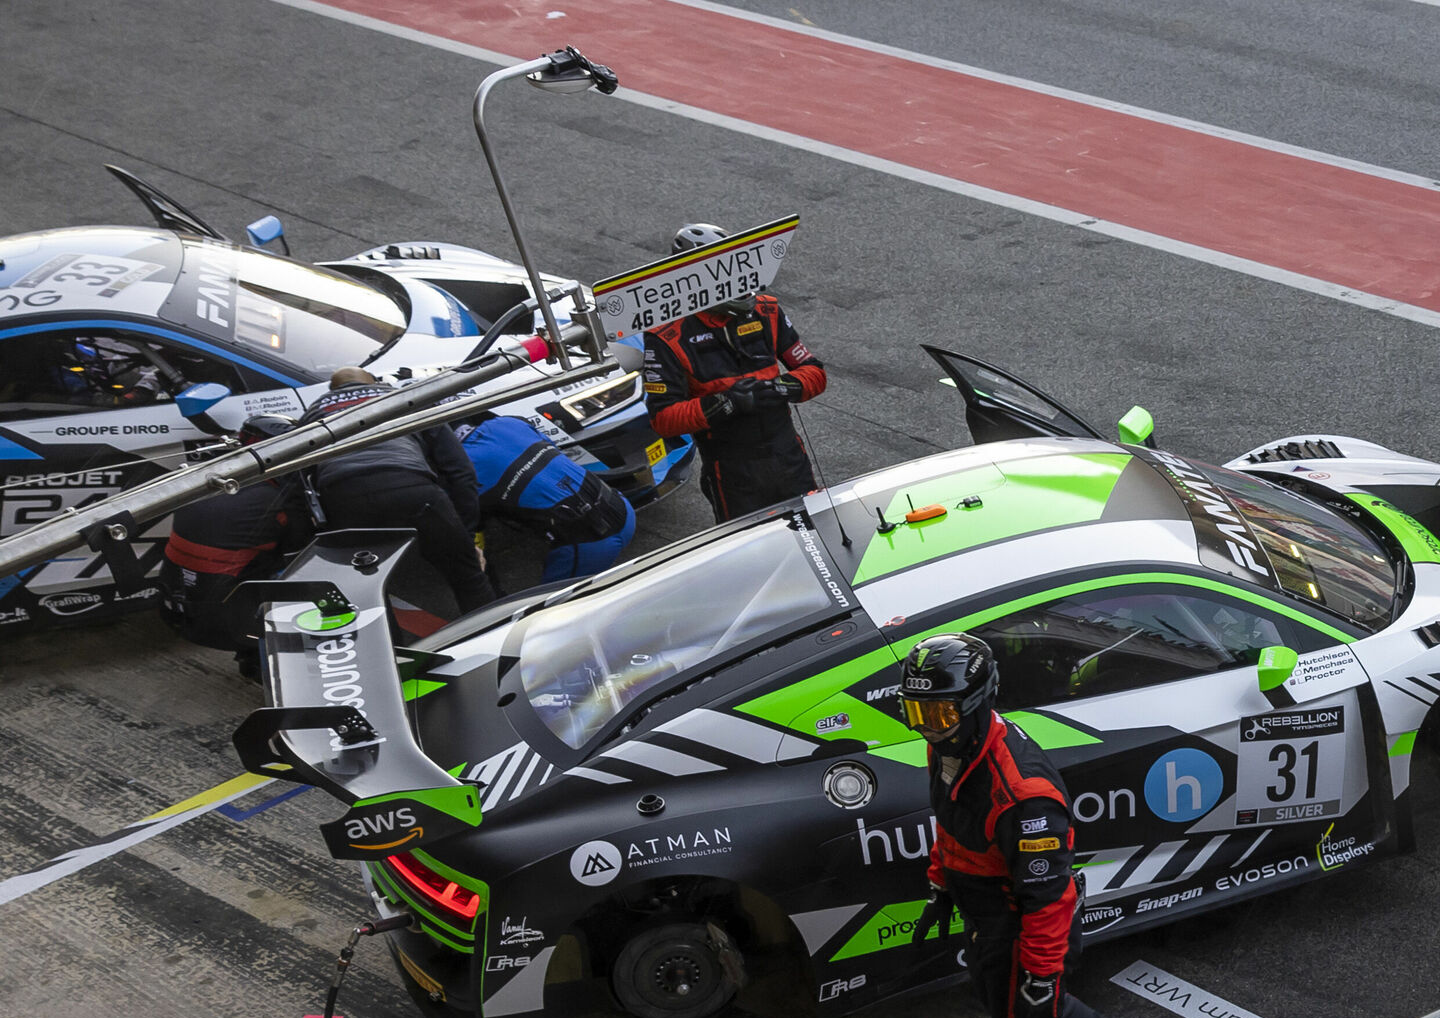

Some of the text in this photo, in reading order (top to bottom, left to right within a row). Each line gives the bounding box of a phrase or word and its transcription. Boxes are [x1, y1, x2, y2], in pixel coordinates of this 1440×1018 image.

[53, 261, 129, 287] 33
[626, 244, 766, 308] Team WRT
[631, 308, 655, 331] 46
[659, 300, 682, 323] 32
[687, 289, 710, 313] 30
[715, 282, 732, 303] 31
[55, 425, 170, 436] GROUPE DIROB
[5, 471, 123, 487] PROJET
[1298, 650, 1350, 667] Hutchison
[1303, 657, 1354, 674] Menchaca
[1304, 668, 1346, 682] Proctor
[866, 684, 901, 701] WR
[816, 714, 839, 730] elf
[1262, 711, 1338, 727] REBELLION
[1266, 740, 1319, 803] 31
[1276, 804, 1324, 820] SILVER
[344, 807, 417, 840] aws
[1022, 820, 1048, 832] OMP
[627, 827, 732, 860] ATMAN
[1322, 836, 1356, 854] Home
[629, 847, 733, 868] FINANCIAL CONSULTANCY
[1323, 842, 1375, 866] Displays
[1215, 855, 1309, 891] EVOSON
[1136, 886, 1204, 914] Snap-on
[1126, 972, 1192, 1008] WRT
